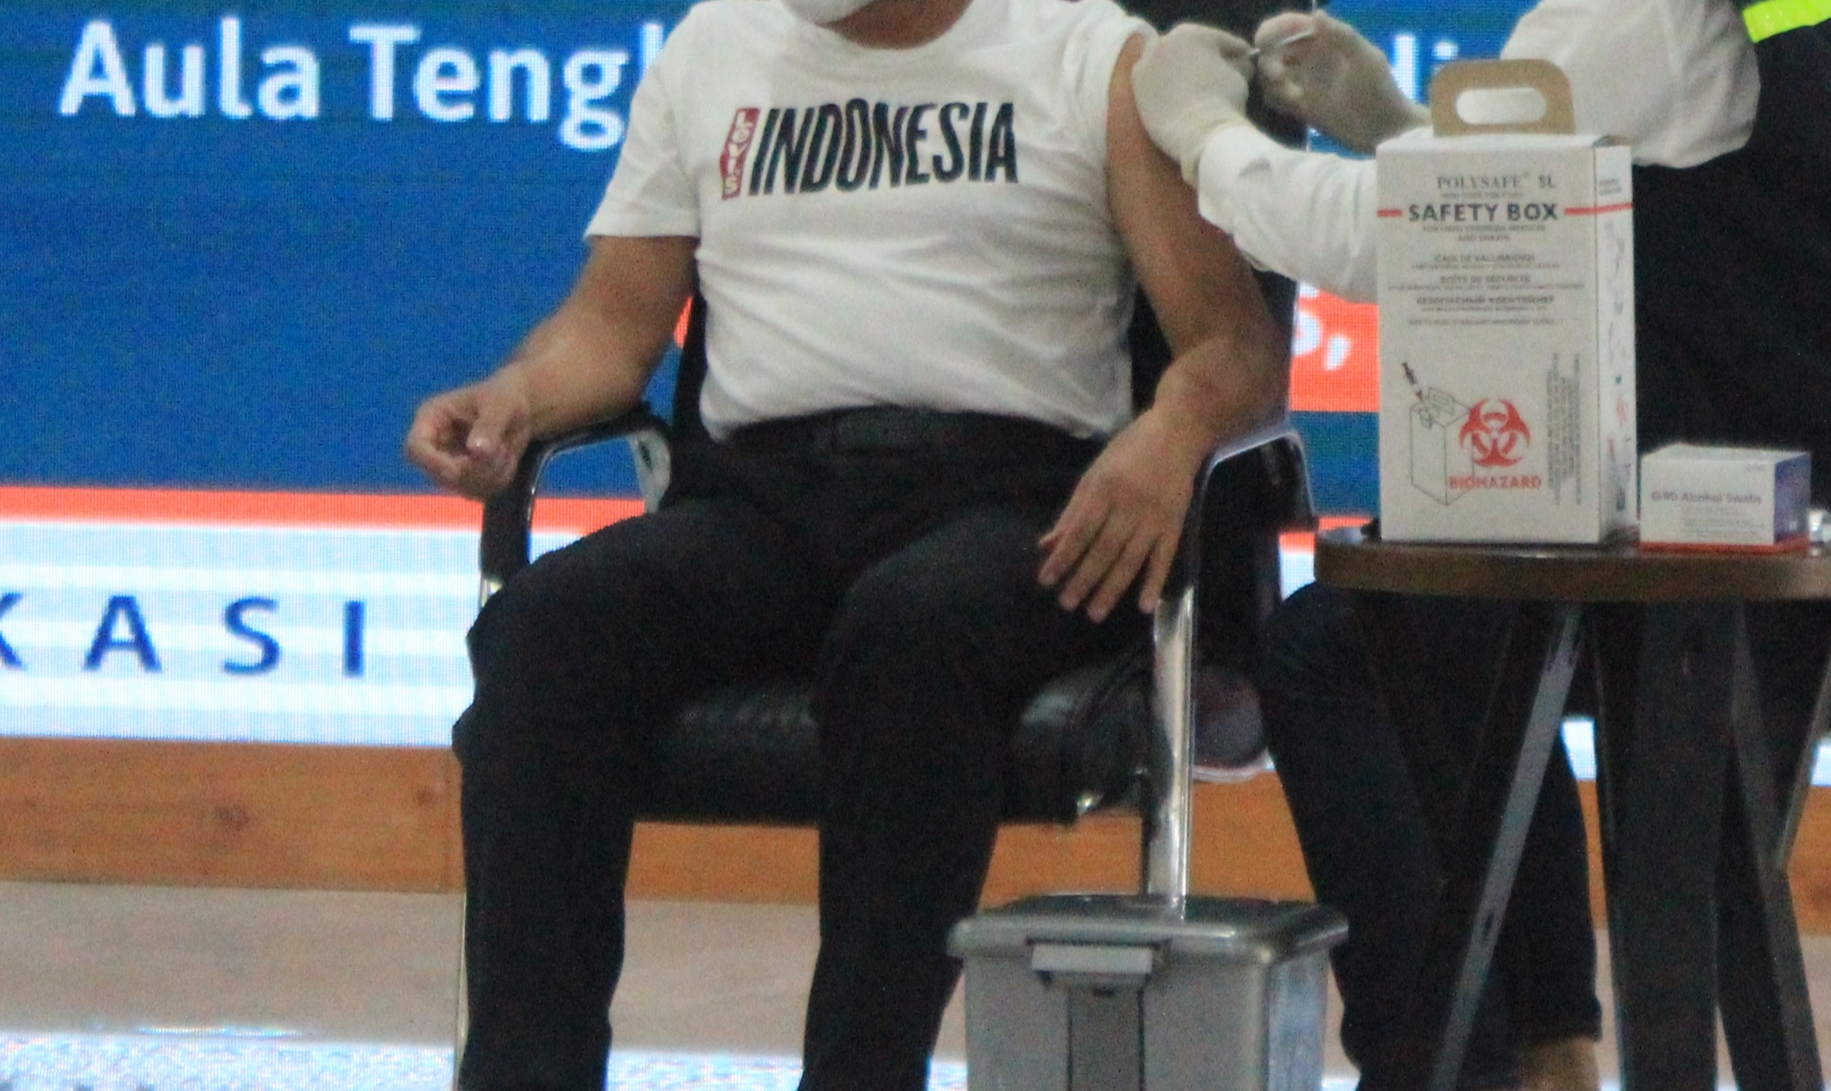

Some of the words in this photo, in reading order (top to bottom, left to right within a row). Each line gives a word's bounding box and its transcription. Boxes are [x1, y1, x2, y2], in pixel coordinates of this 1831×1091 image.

[60, 17, 320, 119] Aula
[350, 22, 664, 150] Teng
[748, 99, 1018, 196] INDONESIA
[1408, 203, 1499, 222] SAFETY
[1507, 202, 1559, 221] BOX
[1449, 475, 1542, 490] BIOHAZARD
